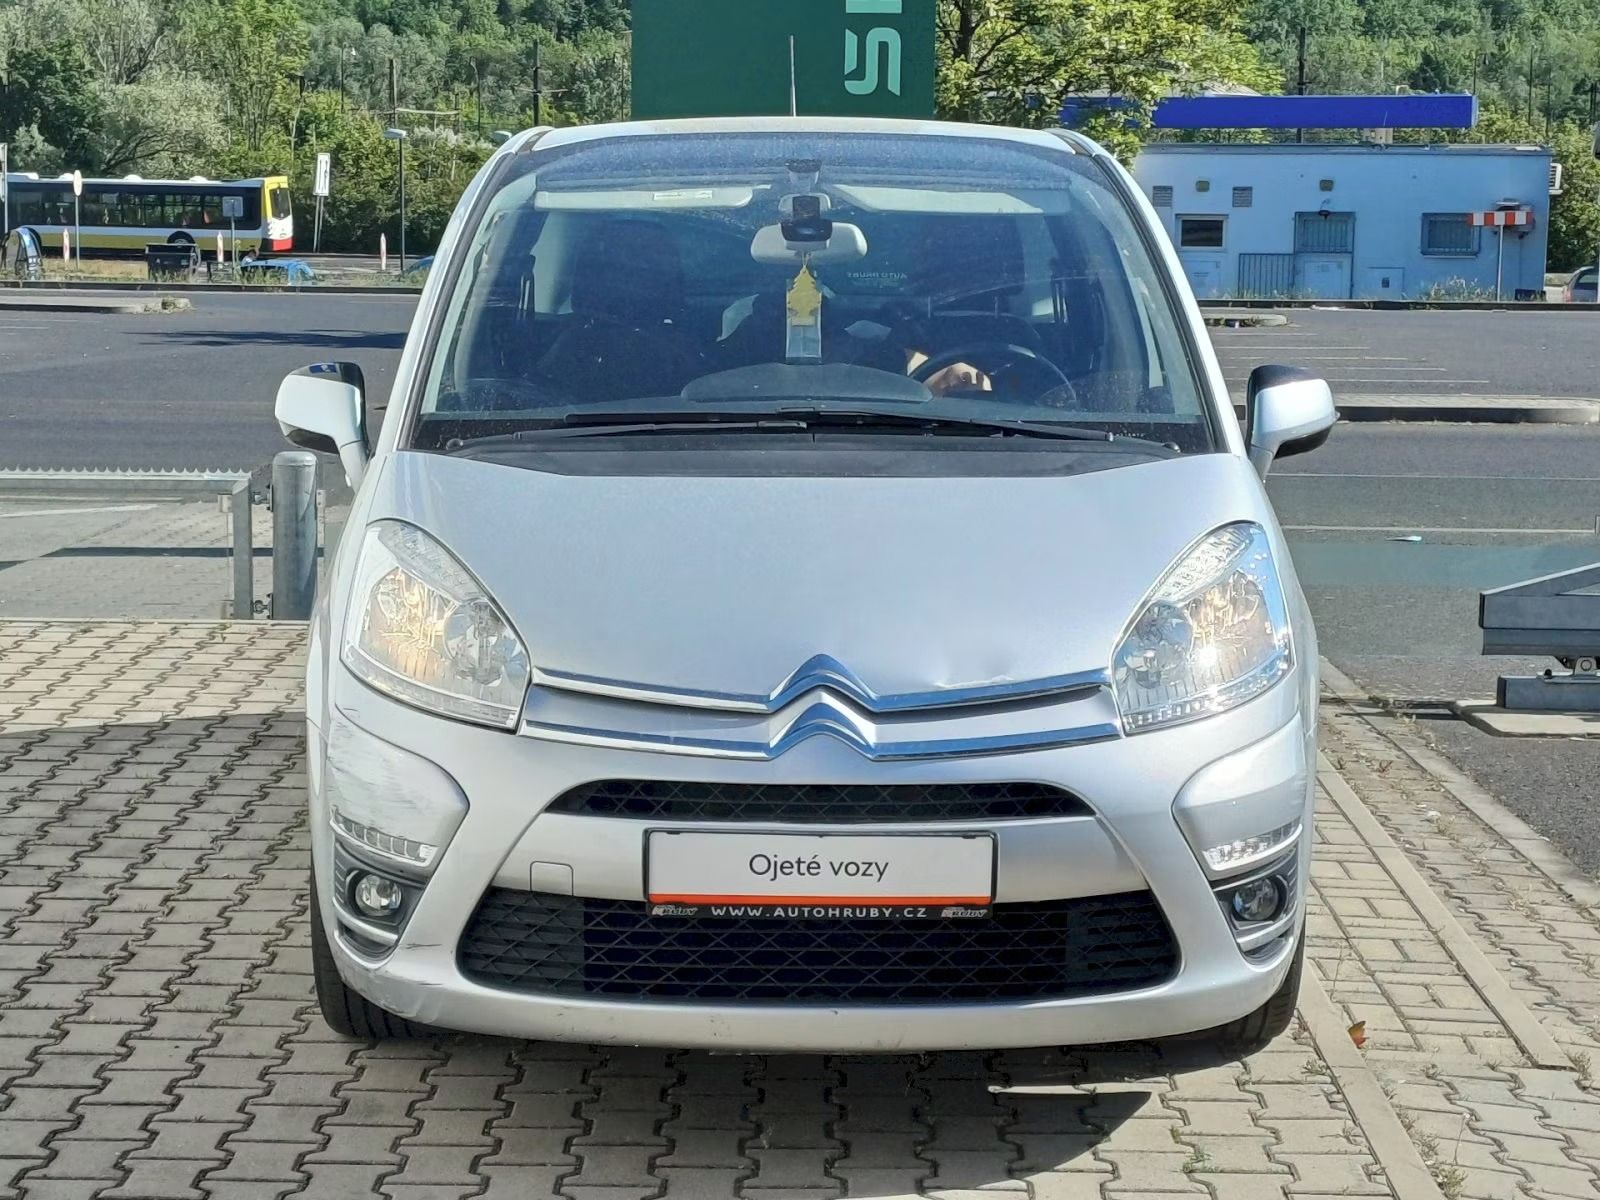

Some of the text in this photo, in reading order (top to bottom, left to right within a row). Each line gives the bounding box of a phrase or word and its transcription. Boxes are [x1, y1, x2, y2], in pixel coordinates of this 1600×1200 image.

[749, 853, 889, 882] Ojeté vozy
[710, 906, 928, 918] WWW.AUTOHRUBY.CZ
